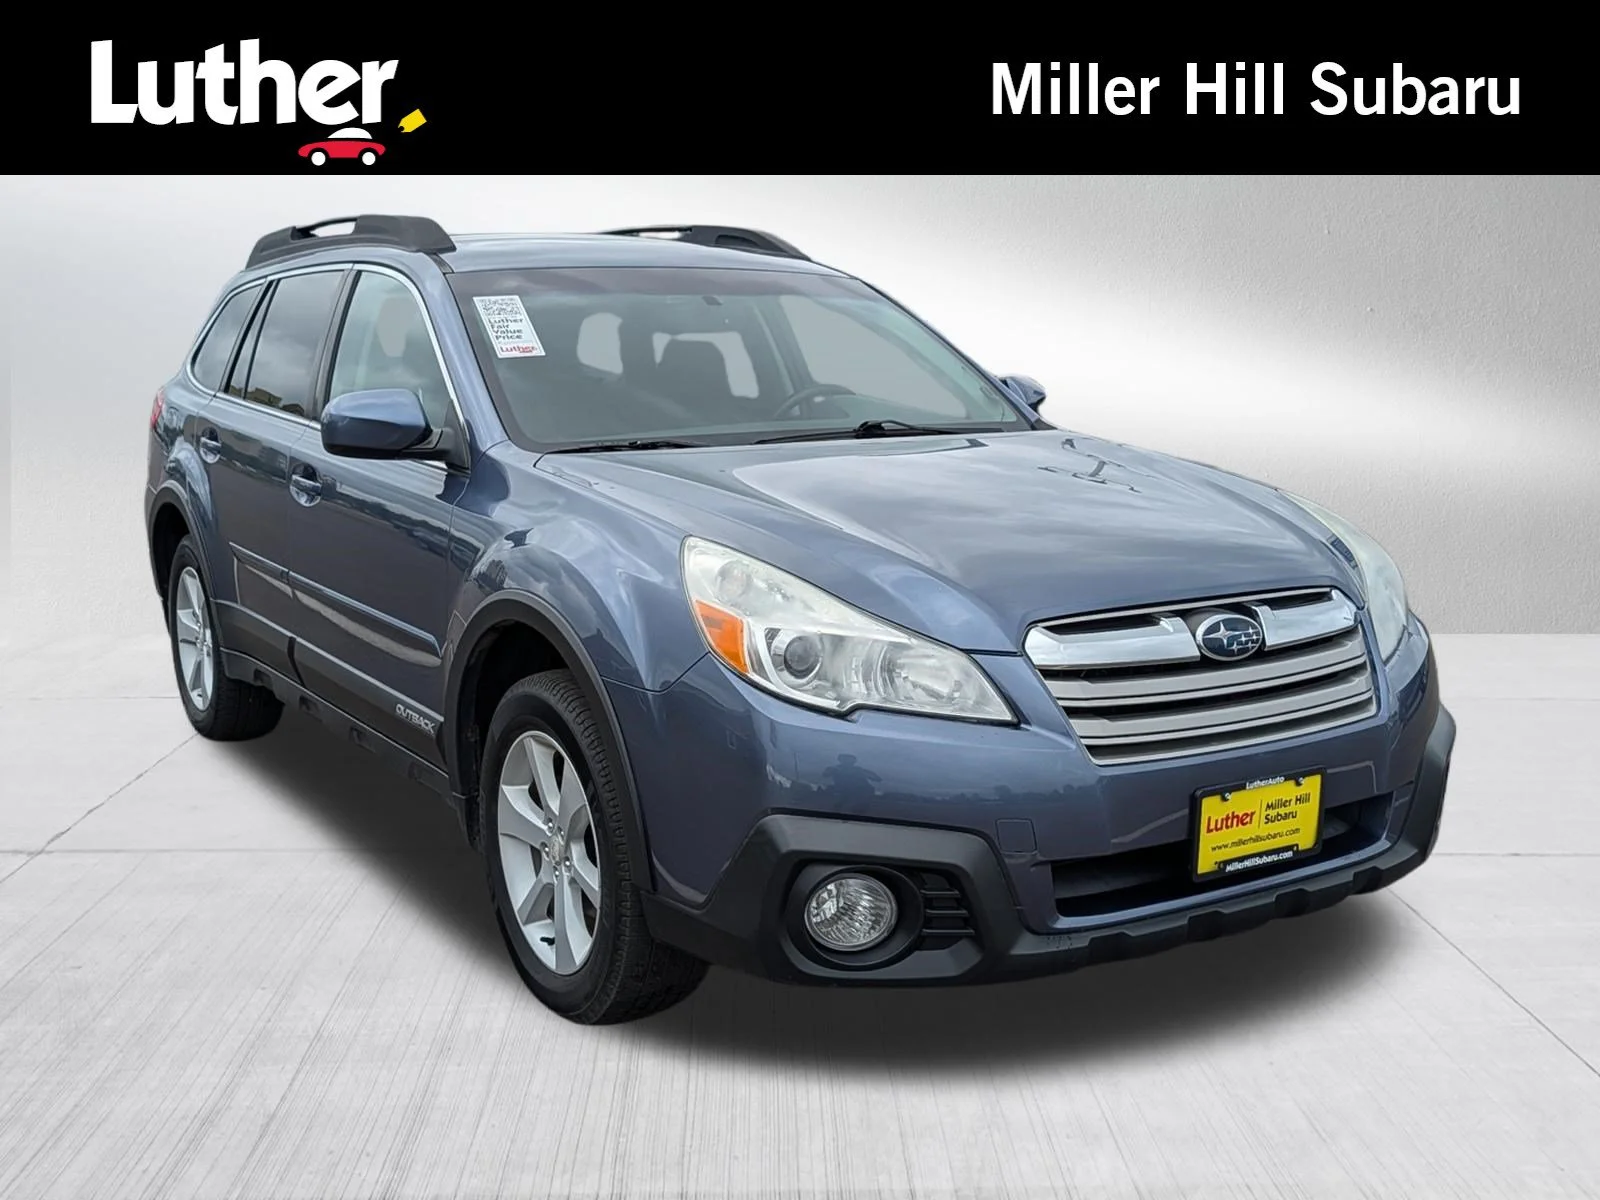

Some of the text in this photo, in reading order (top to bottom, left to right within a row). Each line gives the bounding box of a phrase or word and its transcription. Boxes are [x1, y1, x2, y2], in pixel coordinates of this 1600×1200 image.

[395, 703, 436, 734] OUTBACK
[1245, 776, 1286, 790] LutherAuto
[1264, 792, 1311, 812] Miller Hill
[1205, 809, 1257, 834] Luther
[1264, 810, 1298, 825] Subaru
[1210, 827, 1301, 853] www.millerhillsubaru.com
[1225, 850, 1294, 873] MillerHillSubaru.com
